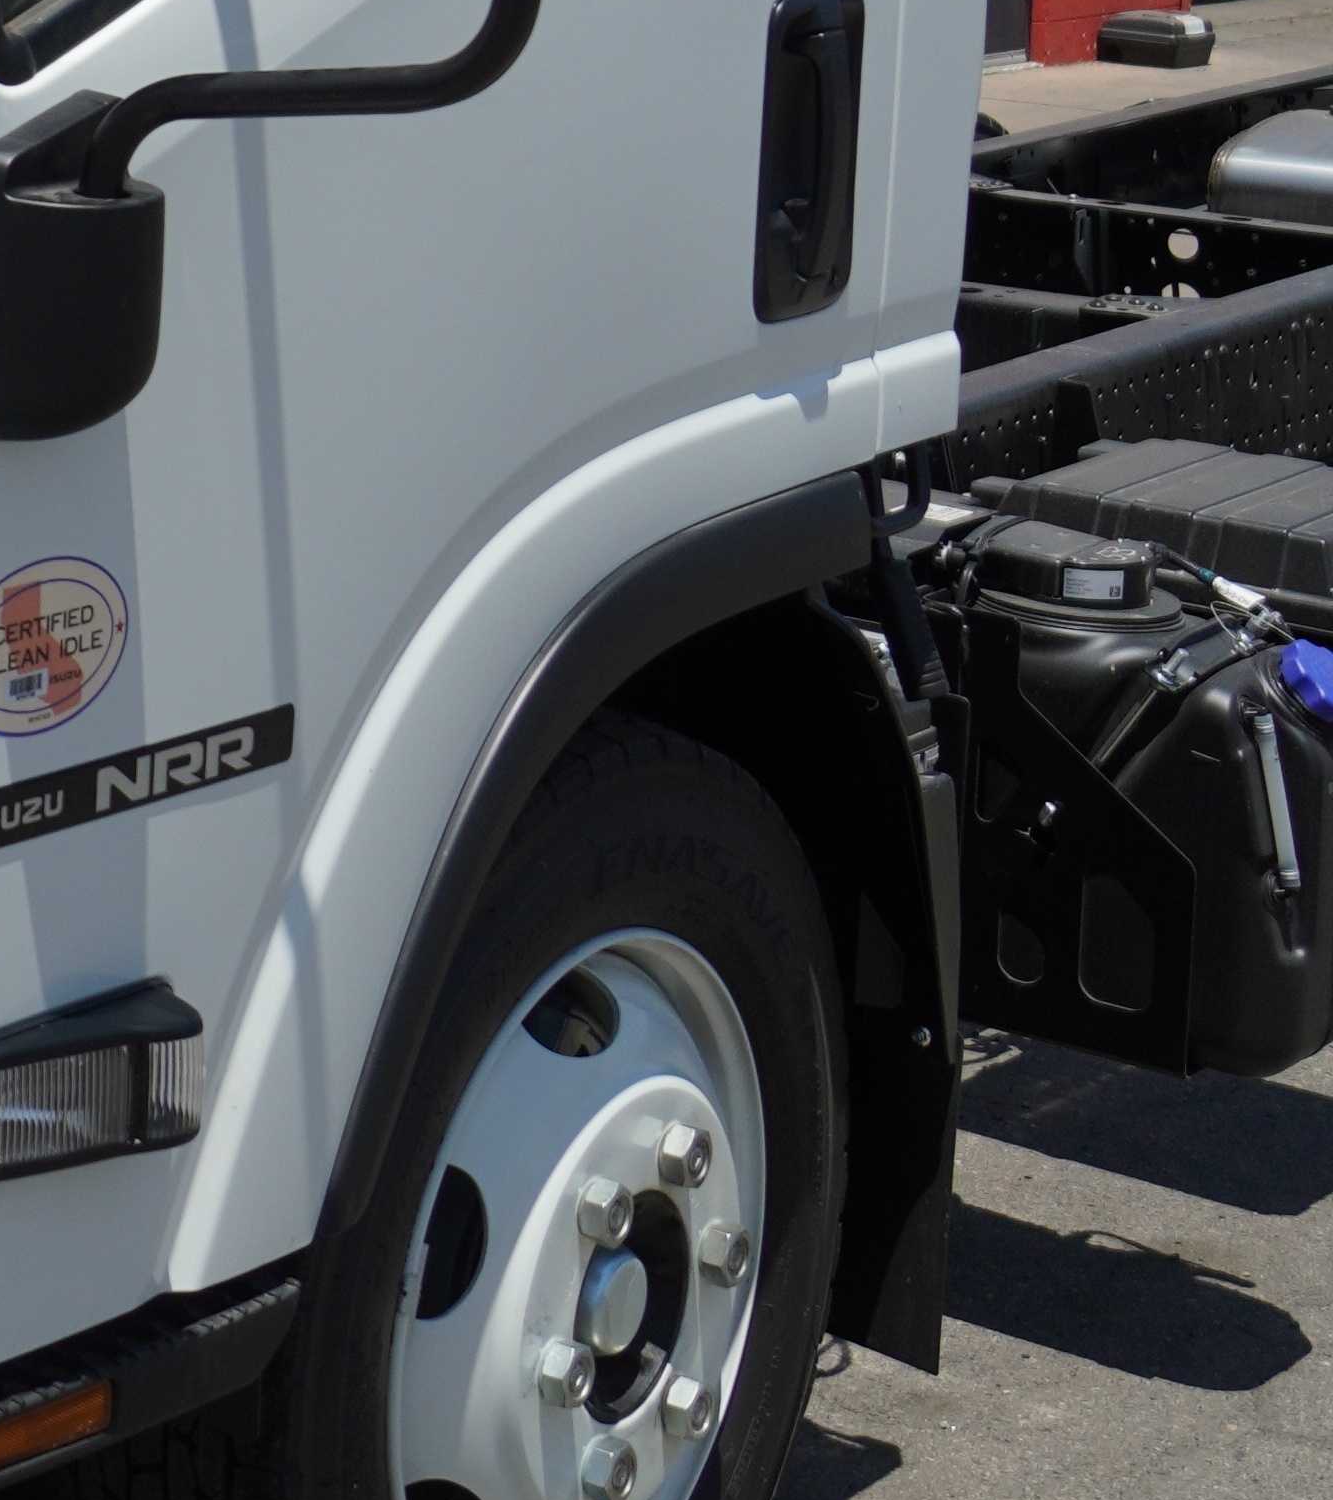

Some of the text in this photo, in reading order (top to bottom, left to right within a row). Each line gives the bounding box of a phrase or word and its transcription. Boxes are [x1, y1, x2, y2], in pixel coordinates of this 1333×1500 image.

[59, 628, 105, 659] IDLE
[48, 667, 84, 685] ISUZU
[95, 724, 256, 814] NRR
